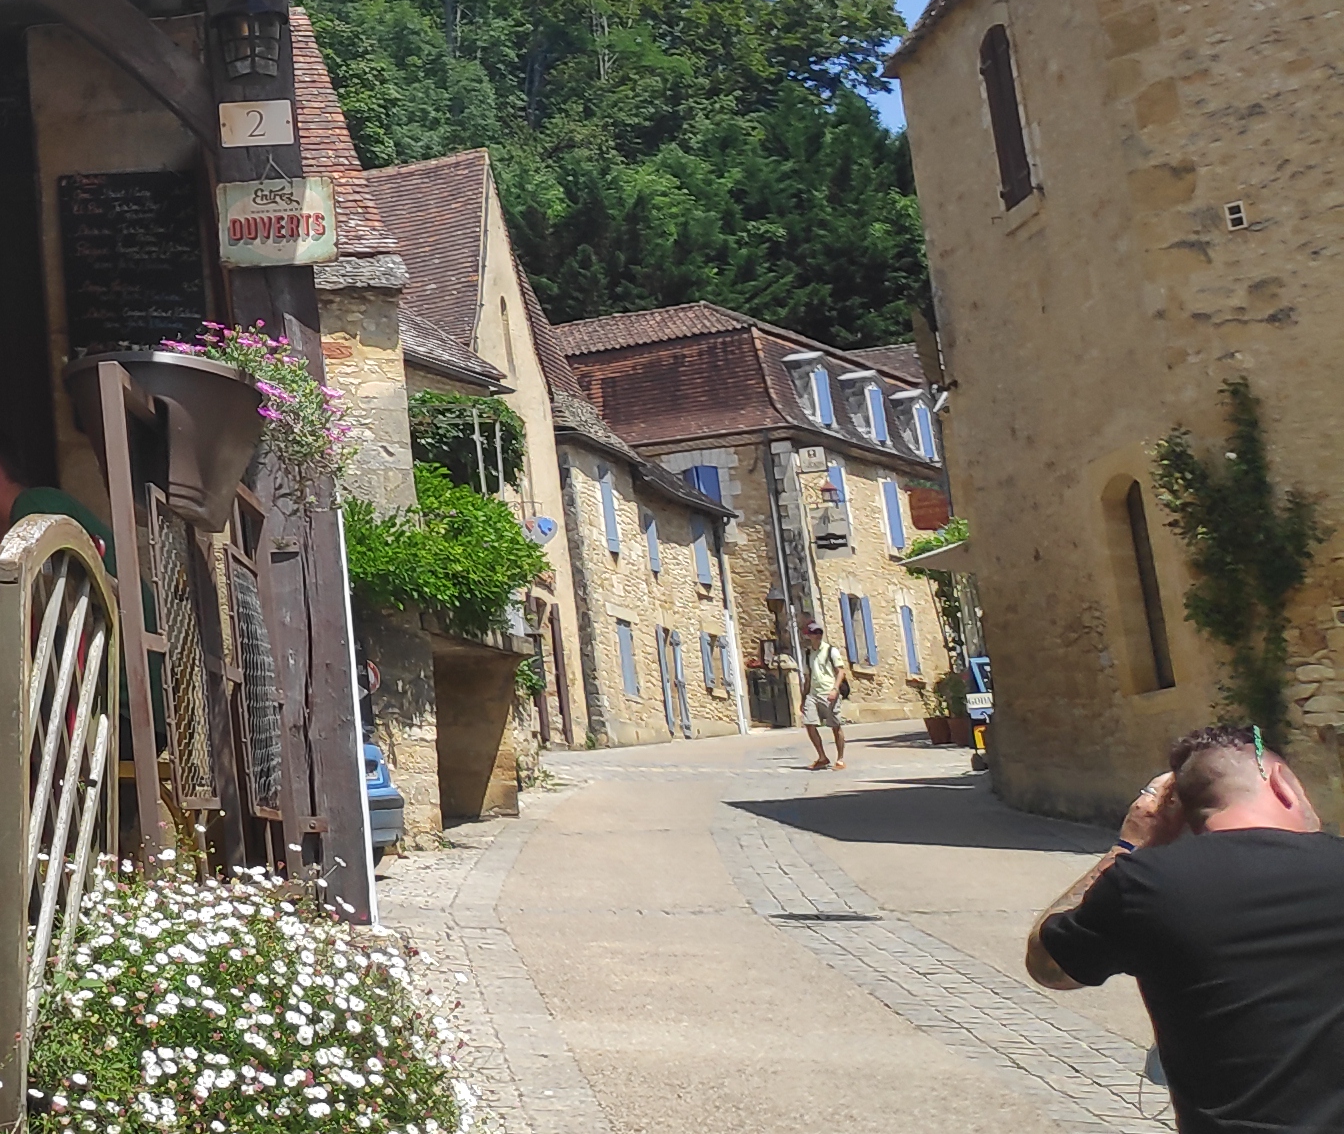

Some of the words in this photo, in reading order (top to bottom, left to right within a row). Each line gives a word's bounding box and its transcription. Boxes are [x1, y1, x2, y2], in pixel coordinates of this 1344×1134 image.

[245, 110, 266, 138] 2
[252, 185, 301, 206] Entrez
[228, 212, 326, 245] OUVERTS
